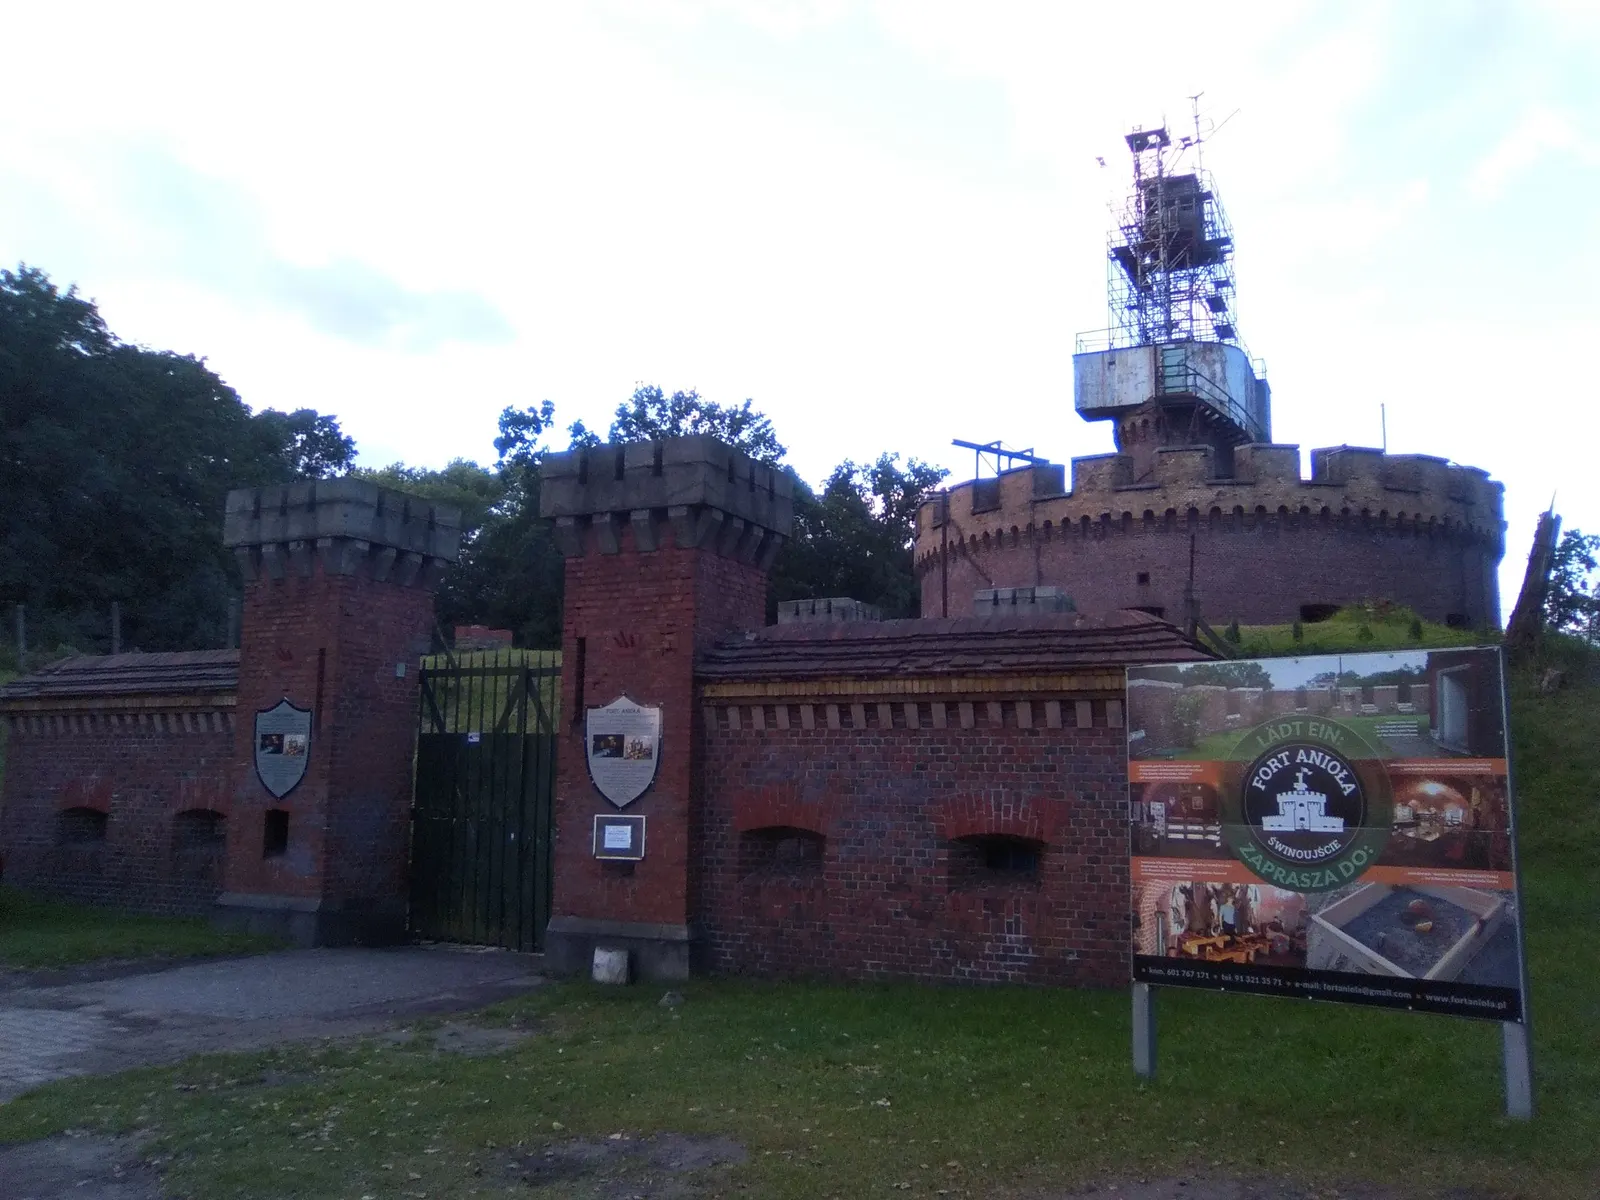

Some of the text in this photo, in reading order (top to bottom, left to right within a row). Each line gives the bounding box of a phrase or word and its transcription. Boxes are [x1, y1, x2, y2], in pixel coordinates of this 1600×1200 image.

[1256, 721, 1303, 747] LÄDT
[1309, 721, 1345, 746] EIN:
[1252, 749, 1356, 796] FORT ANIOŁA
[1268, 836, 1342, 860] ŚWINOUJŚCIE
[1240, 842, 1339, 888] ZAPRASZA
[1339, 844, 1374, 877] DO:
[1167, 968, 1179, 977] 601
[1181, 969, 1194, 978] 767
[1235, 974, 1244, 983] 91
[1246, 975, 1259, 984] 321
[1261, 976, 1271, 985] 35
[1273, 977, 1282, 986] 71
